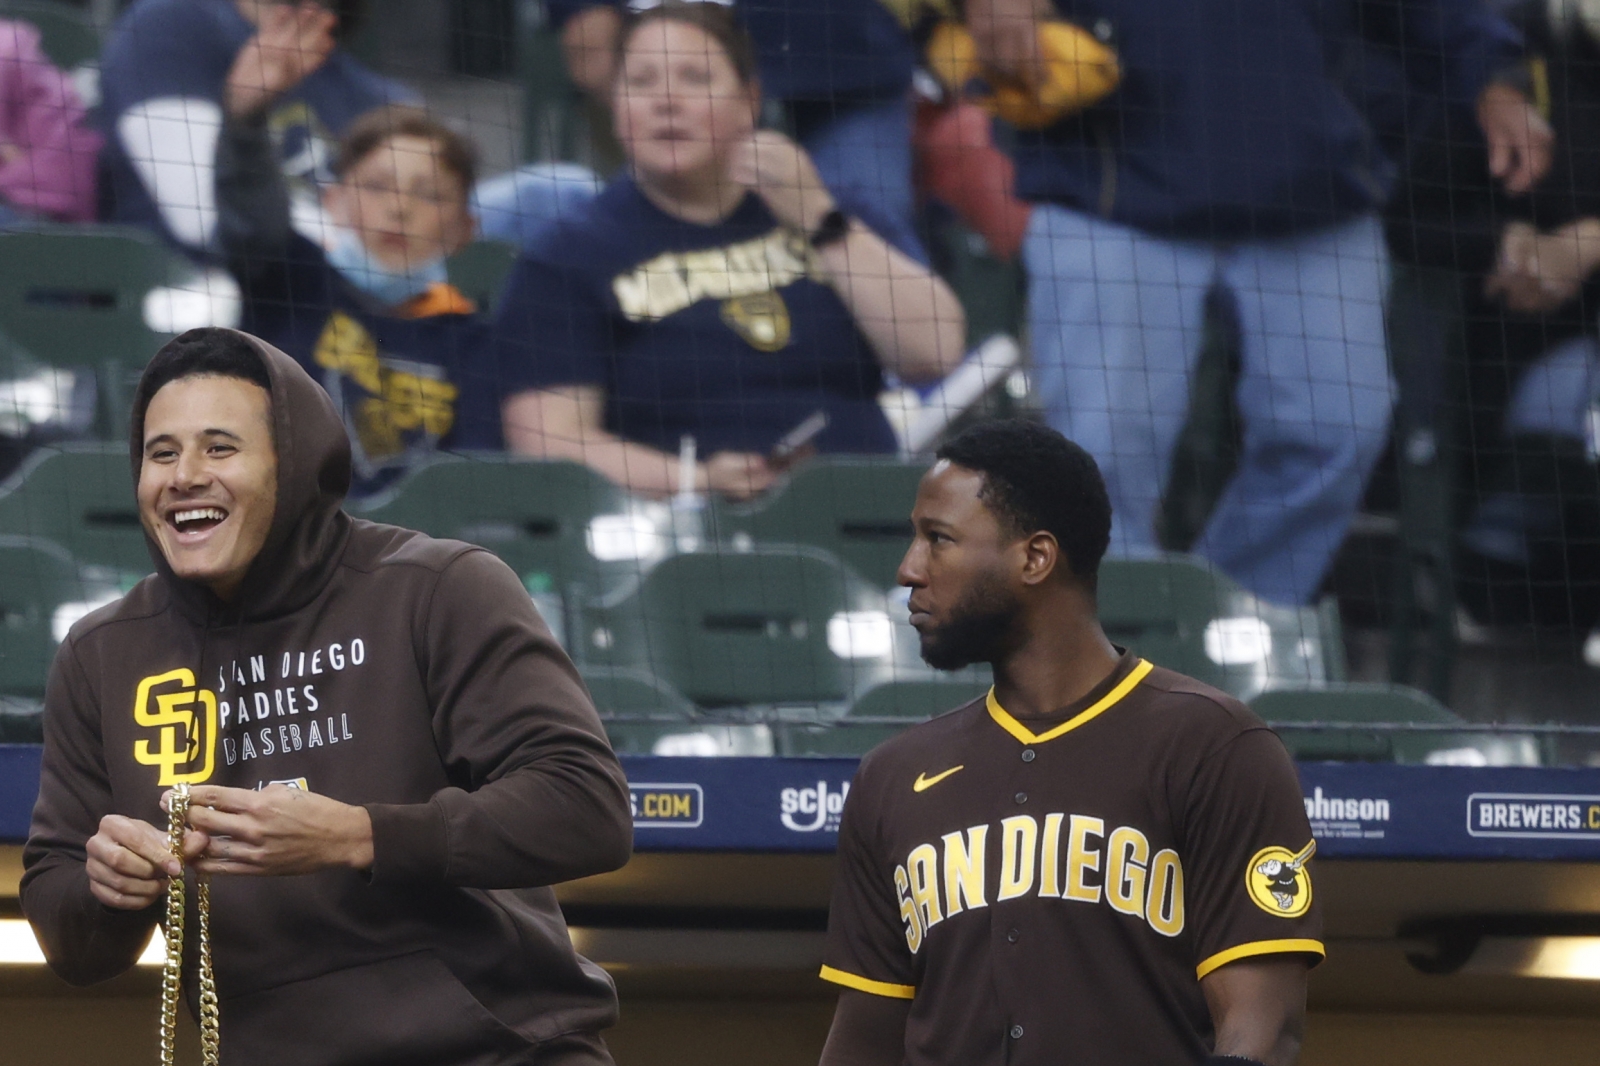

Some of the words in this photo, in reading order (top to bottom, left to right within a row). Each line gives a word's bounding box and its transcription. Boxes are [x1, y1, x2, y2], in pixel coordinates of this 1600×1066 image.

[281, 638, 366, 679] DIEGO
[219, 684, 319, 729] PADRES
[222, 713, 353, 766] BASEBALL
[894, 824, 989, 954] SAN
[997, 813, 1185, 937] DIEGO
